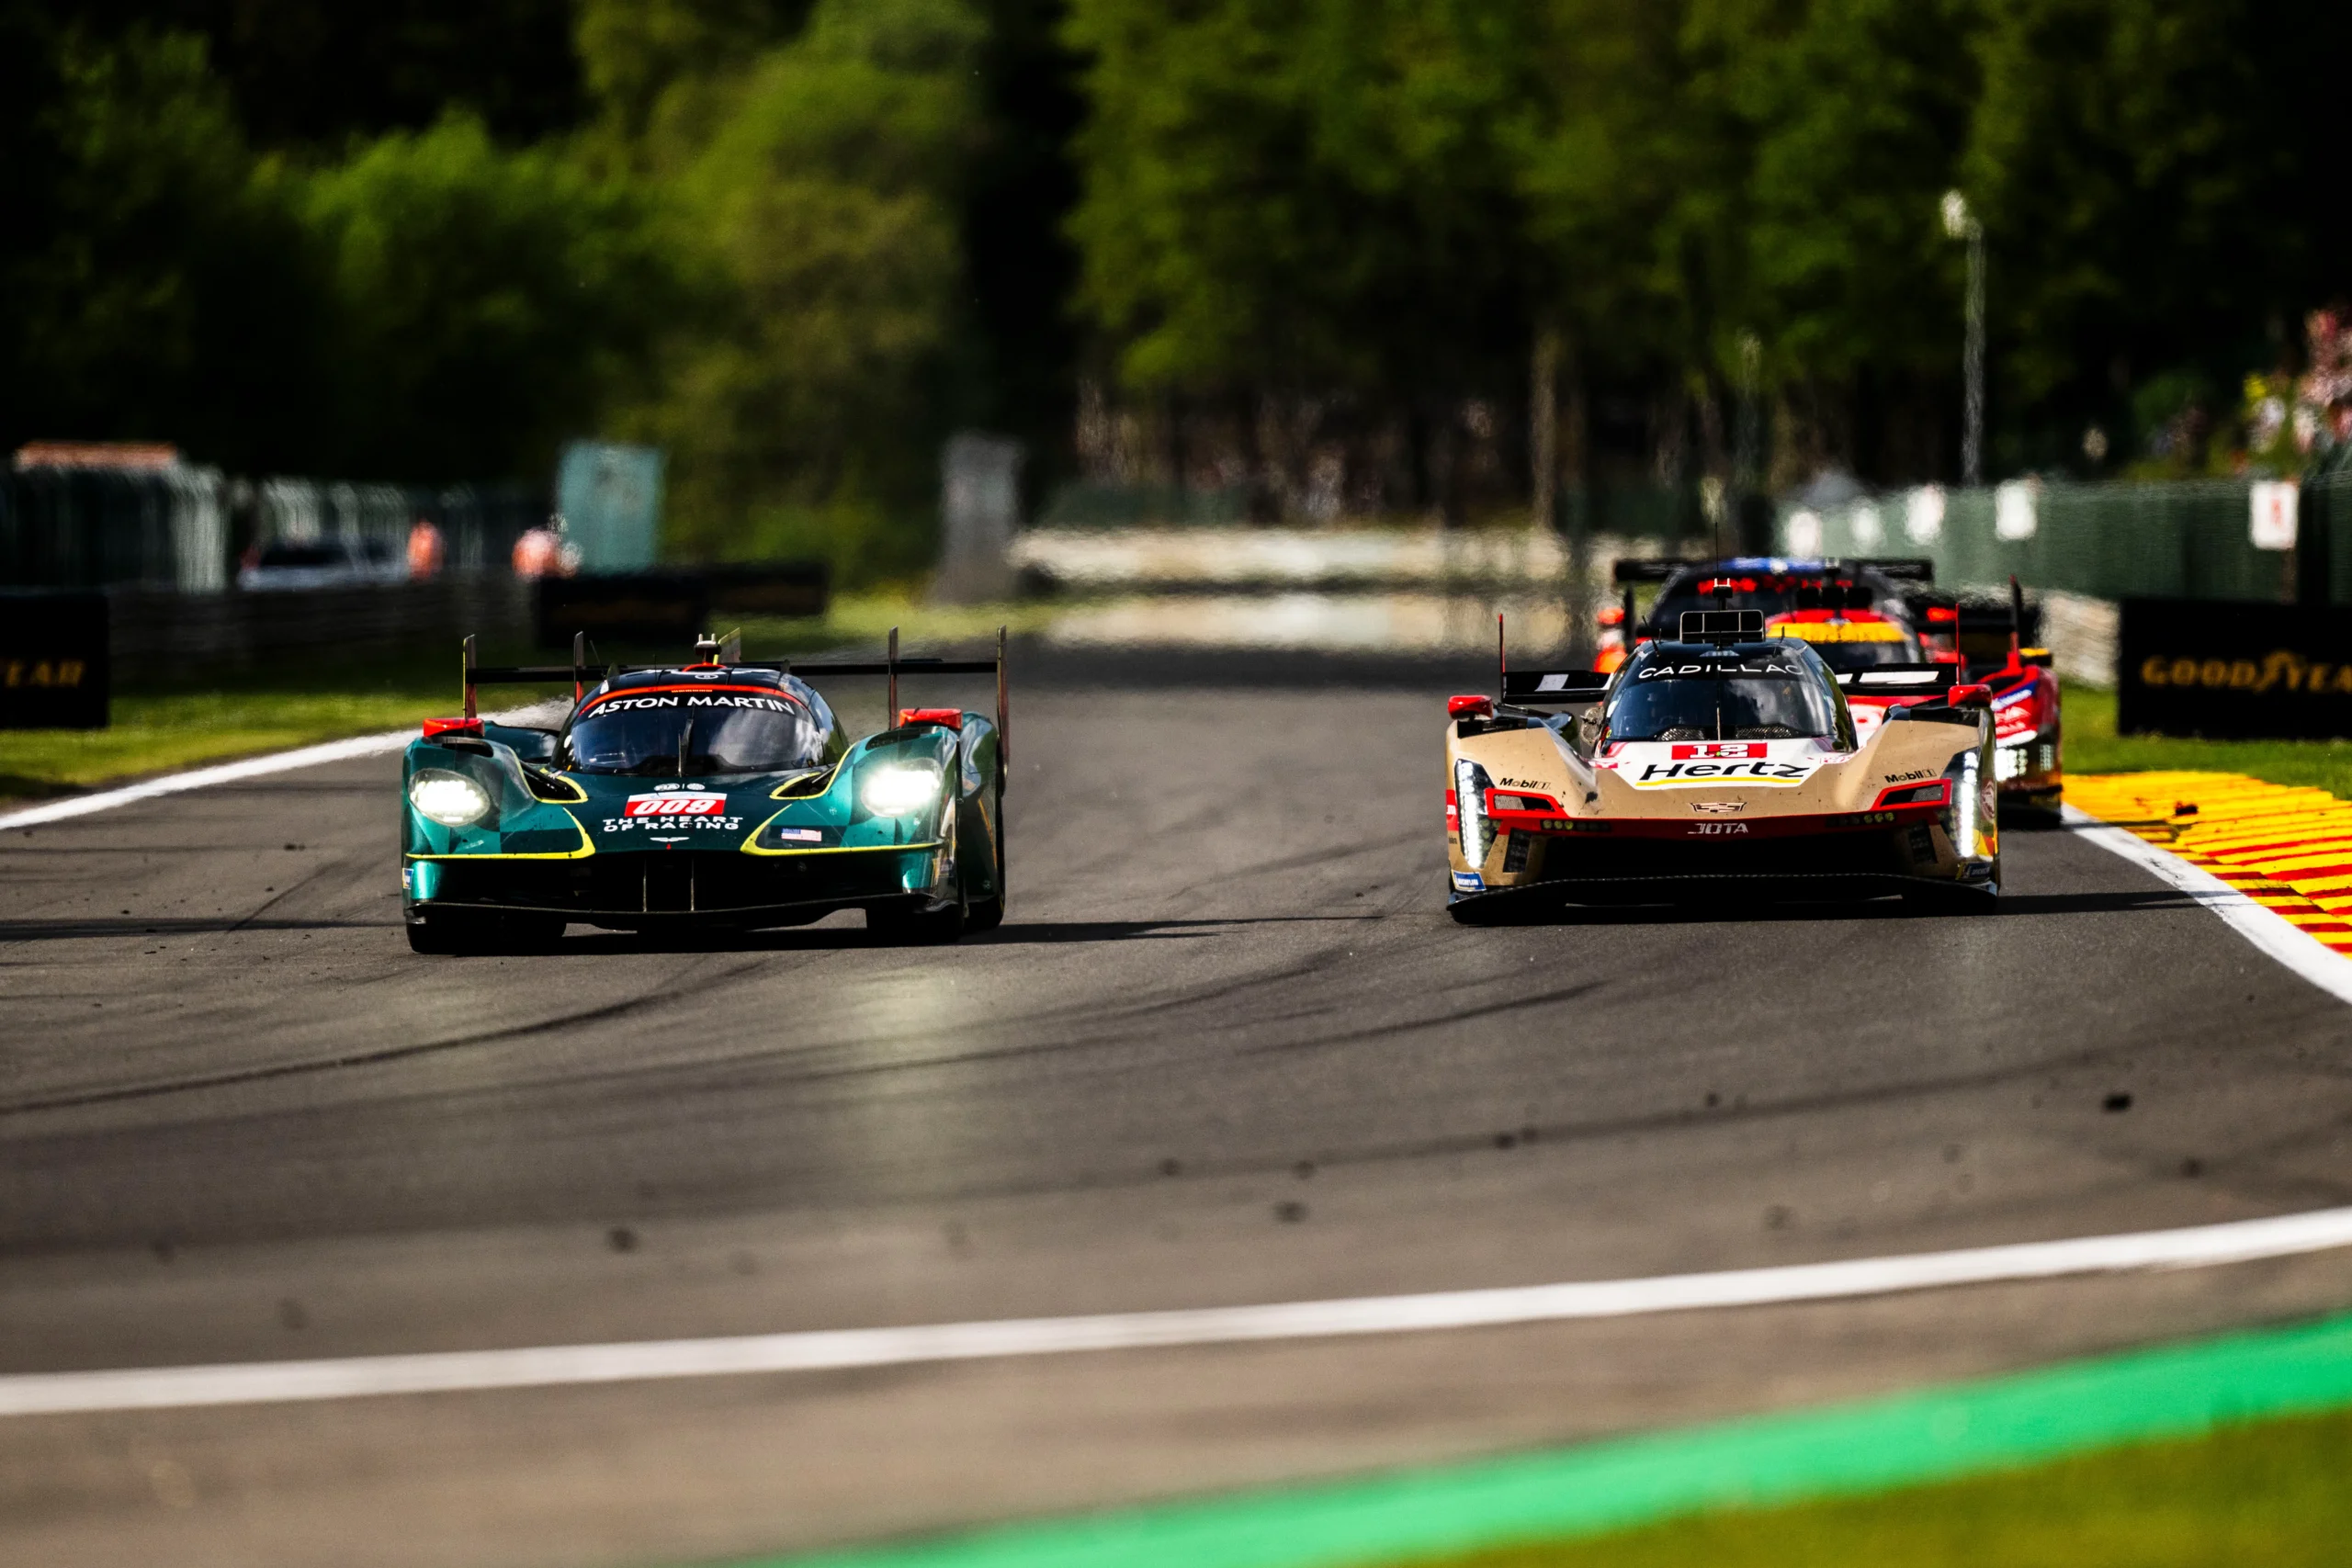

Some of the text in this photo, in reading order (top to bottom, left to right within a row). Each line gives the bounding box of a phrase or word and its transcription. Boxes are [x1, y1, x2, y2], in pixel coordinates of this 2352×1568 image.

[0, 659, 87, 687] EAR
[1638, 664, 1804, 679] CADILLAC
[588, 696, 796, 718] ASTON MARTIN
[1639, 761, 1810, 781] Hertz
[1885, 770, 1924, 783] Mobil
[1499, 778, 1537, 789] Mobil
[633, 799, 717, 815] 009
[603, 817, 650, 826] THE
[604, 822, 739, 832] OF RACING
[1688, 823, 1749, 834] JOTA
